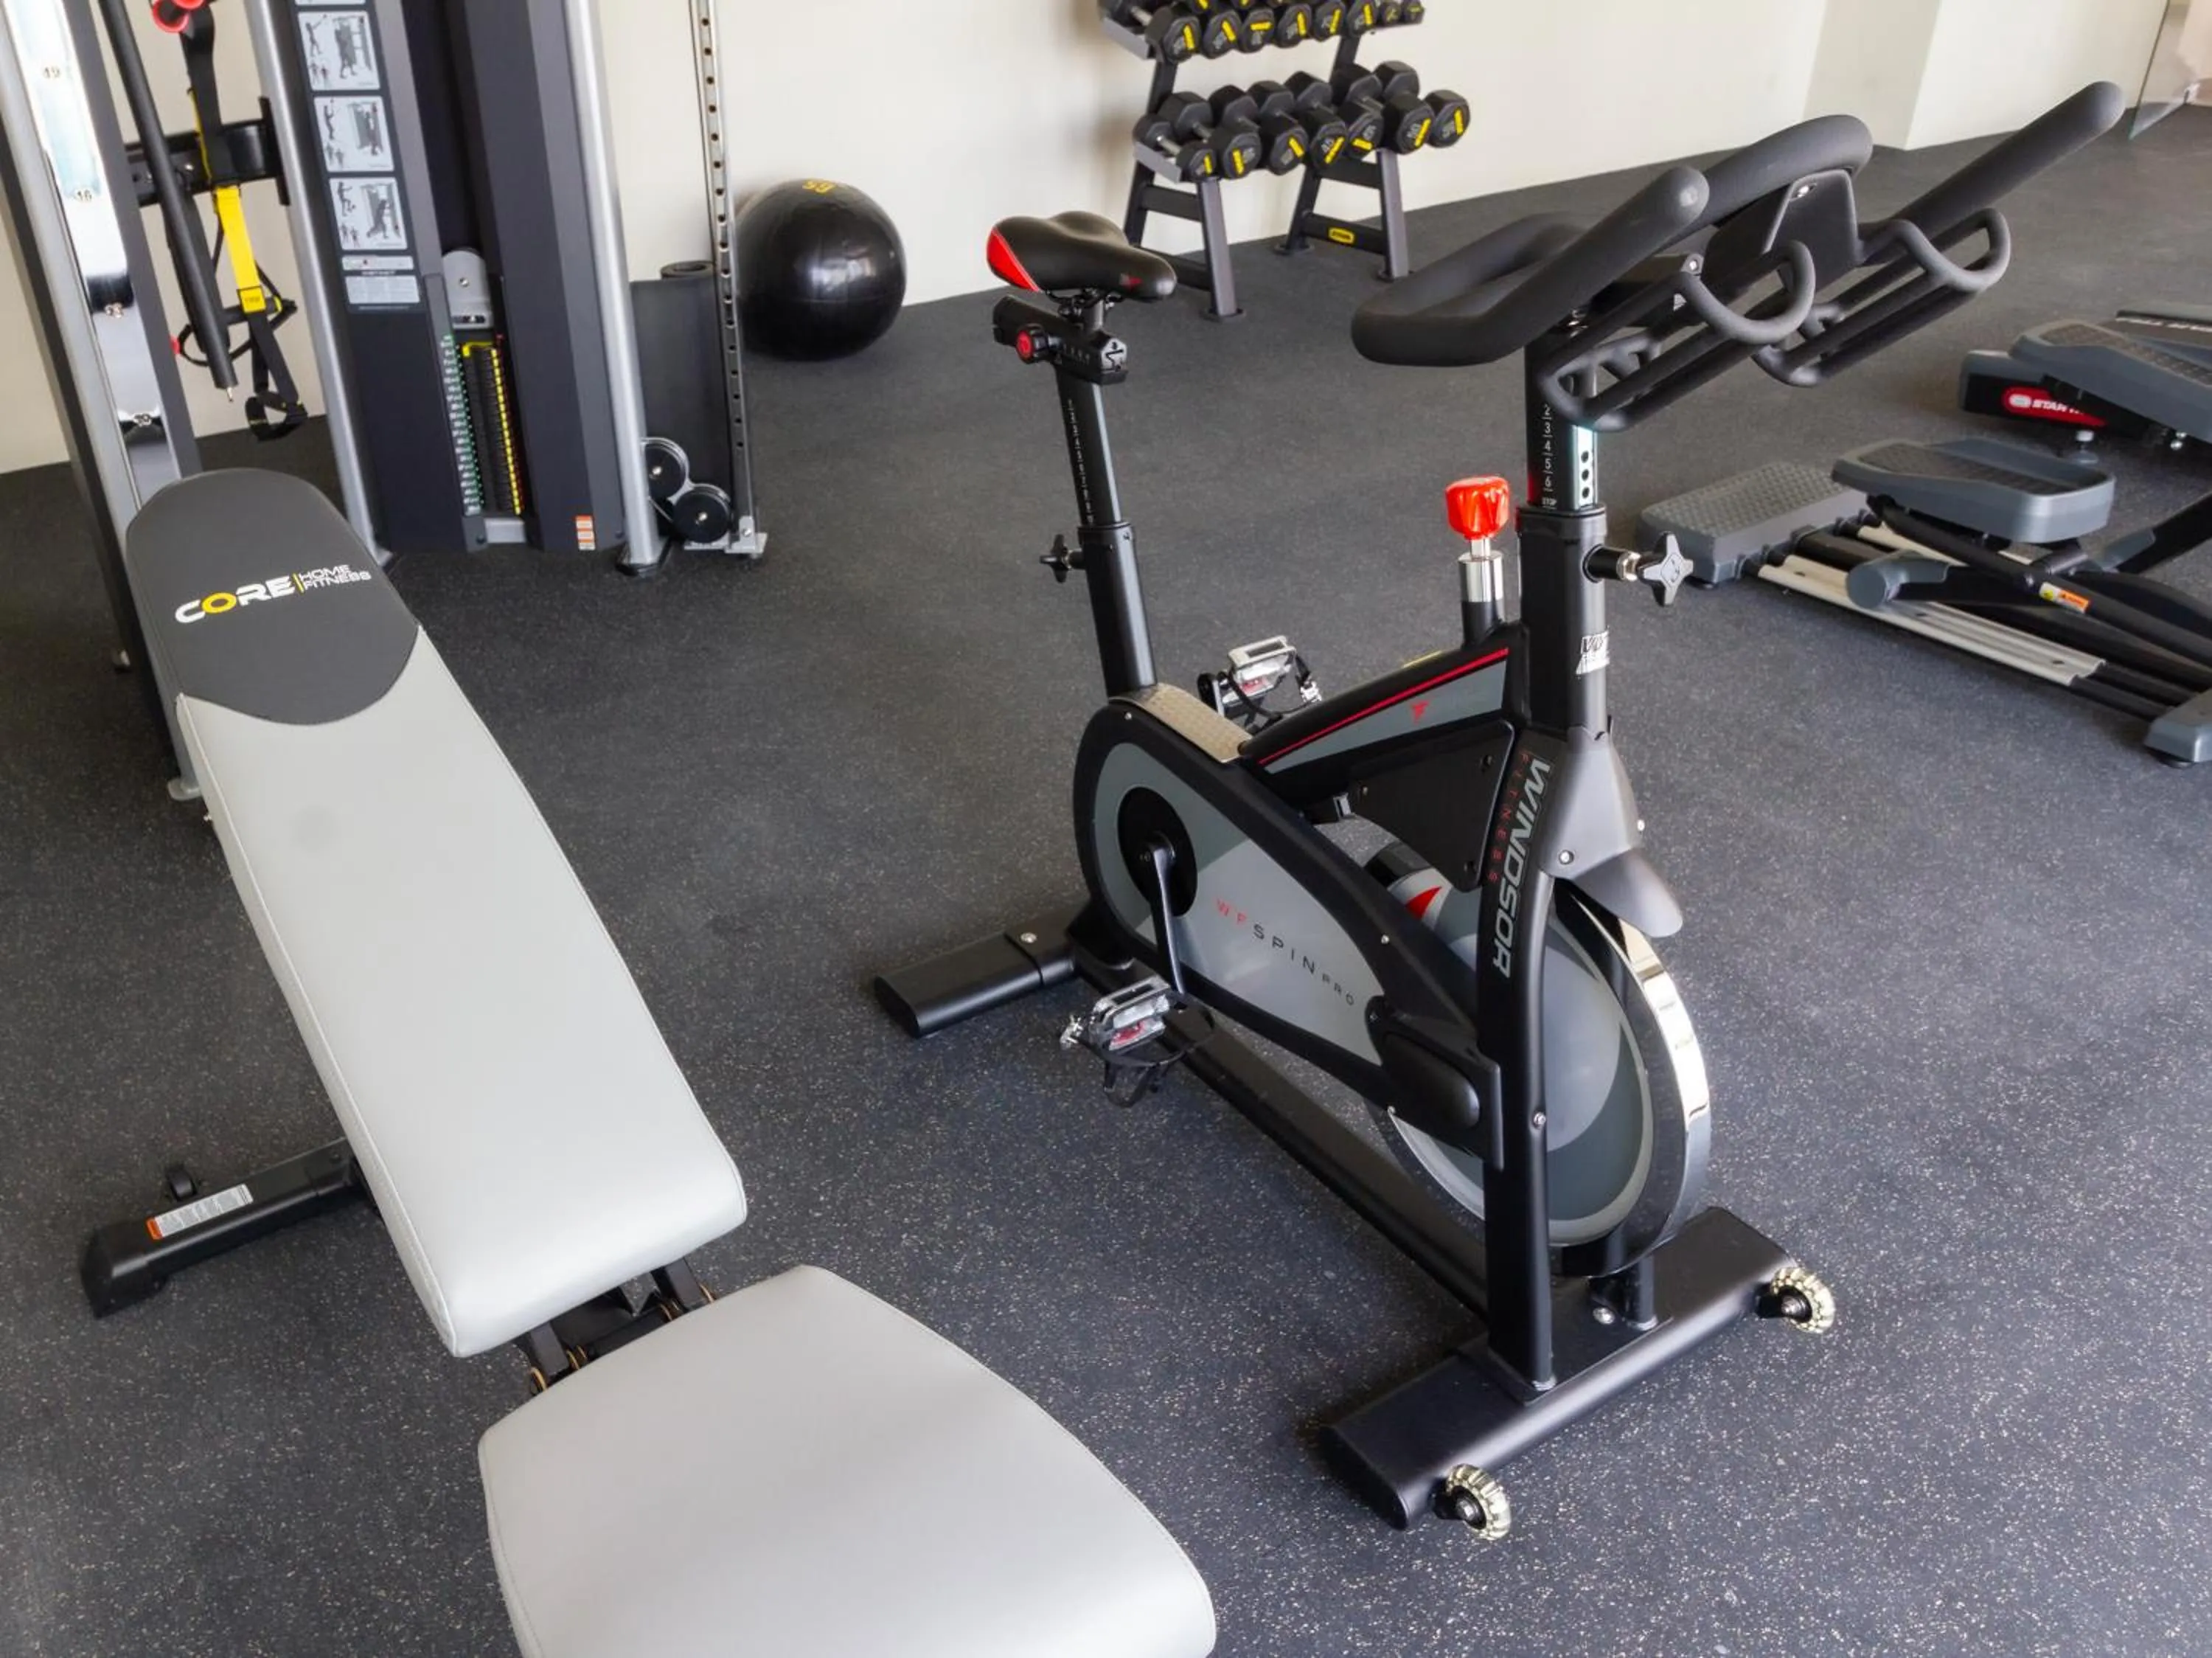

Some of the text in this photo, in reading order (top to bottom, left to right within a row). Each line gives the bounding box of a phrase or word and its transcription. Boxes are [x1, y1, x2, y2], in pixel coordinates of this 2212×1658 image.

[299, 564, 351, 582] HOME
[303, 571, 372, 590] FITNESS
[175, 575, 296, 623] CORE
[1492, 758, 1550, 978] WINDSOR
